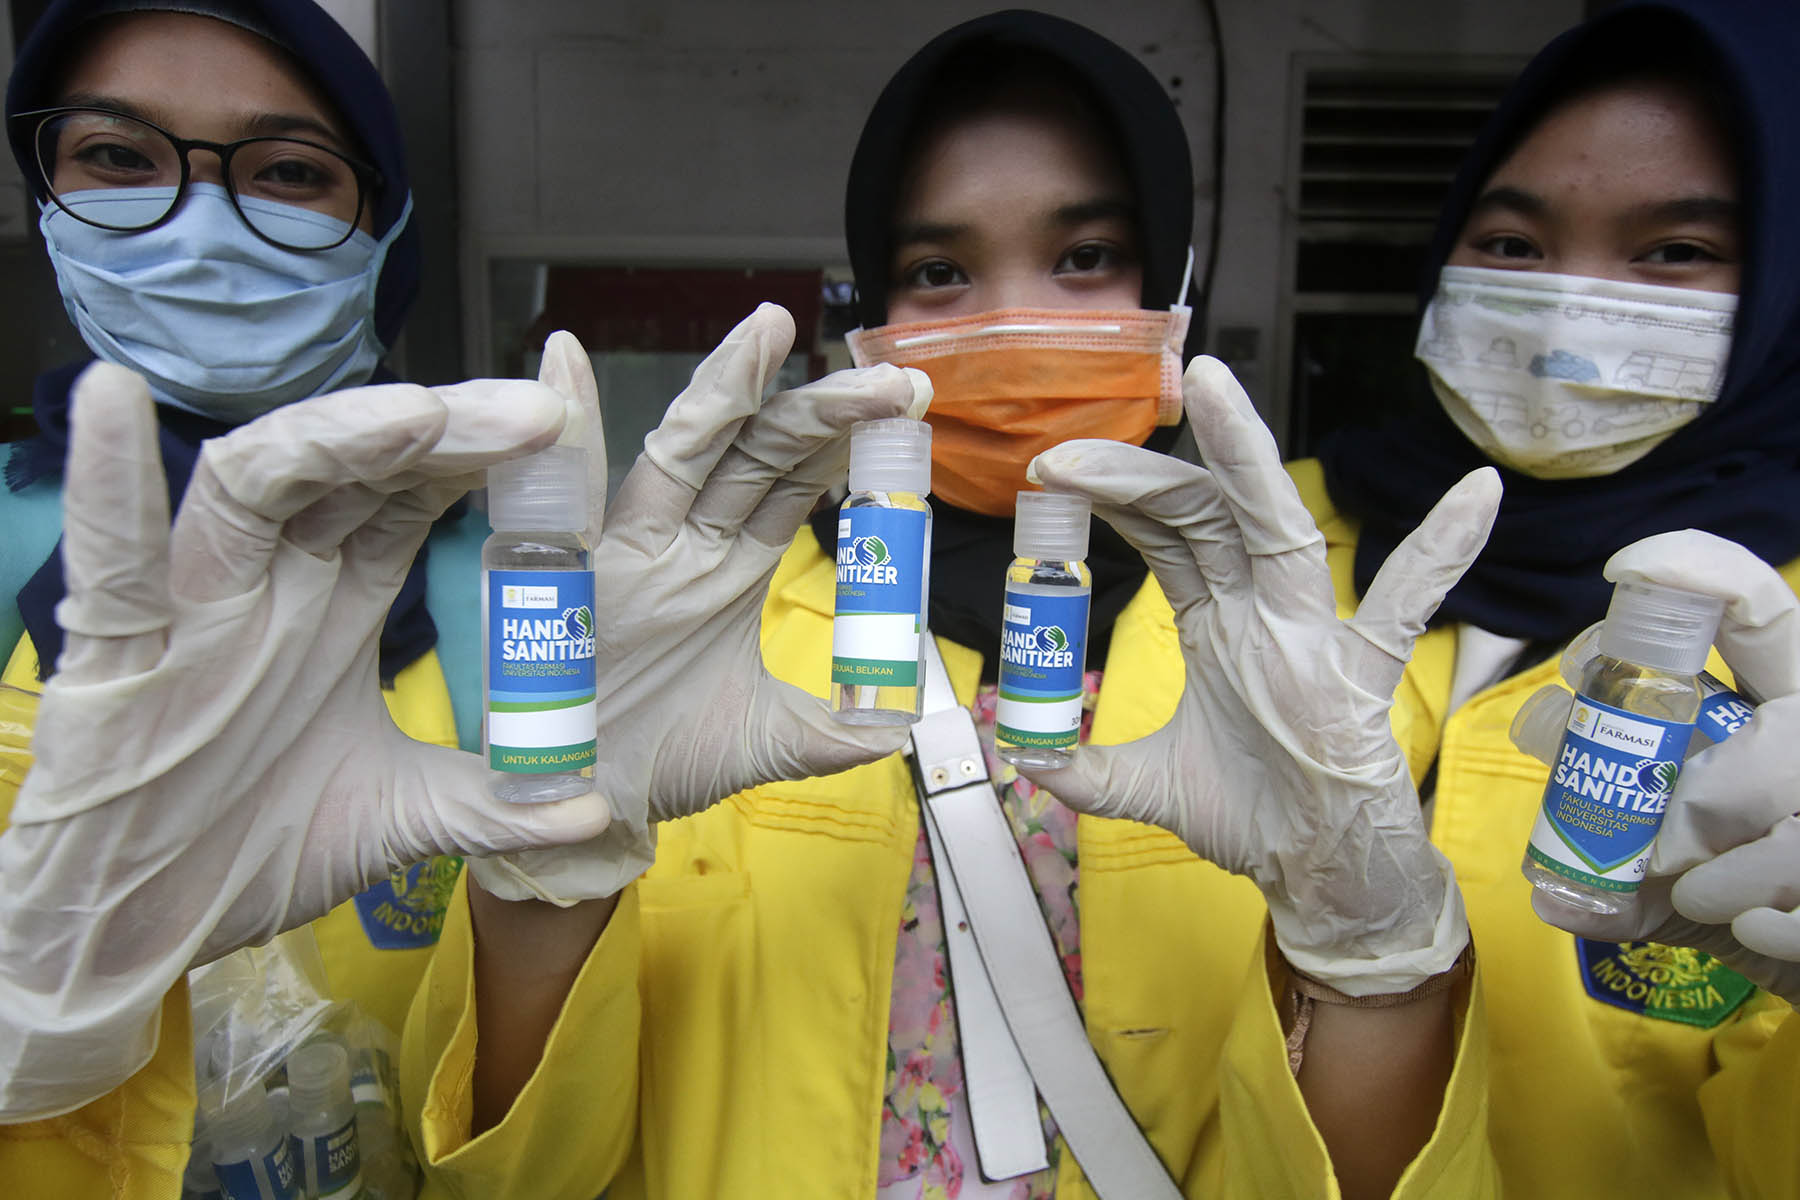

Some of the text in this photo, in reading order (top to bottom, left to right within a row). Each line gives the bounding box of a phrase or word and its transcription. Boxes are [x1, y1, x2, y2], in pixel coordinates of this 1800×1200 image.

[502, 618, 567, 640] HAND
[1001, 628, 1037, 650] HAND
[1000, 643, 1074, 668] SANITIZER
[855, 665, 895, 676] BELIKAN
[1599, 725, 1656, 748] FARMASI
[502, 754, 539, 765] UNTUK
[540, 749, 591, 765] KALANGAN
[1560, 743, 1639, 788] HAND
[1559, 801, 1630, 833] UNIVERSITAS
[1561, 790, 1616, 819] FAKULTAS
[1555, 809, 1615, 839] INDONESIA
[1591, 956, 1726, 1009] INDONESIA
